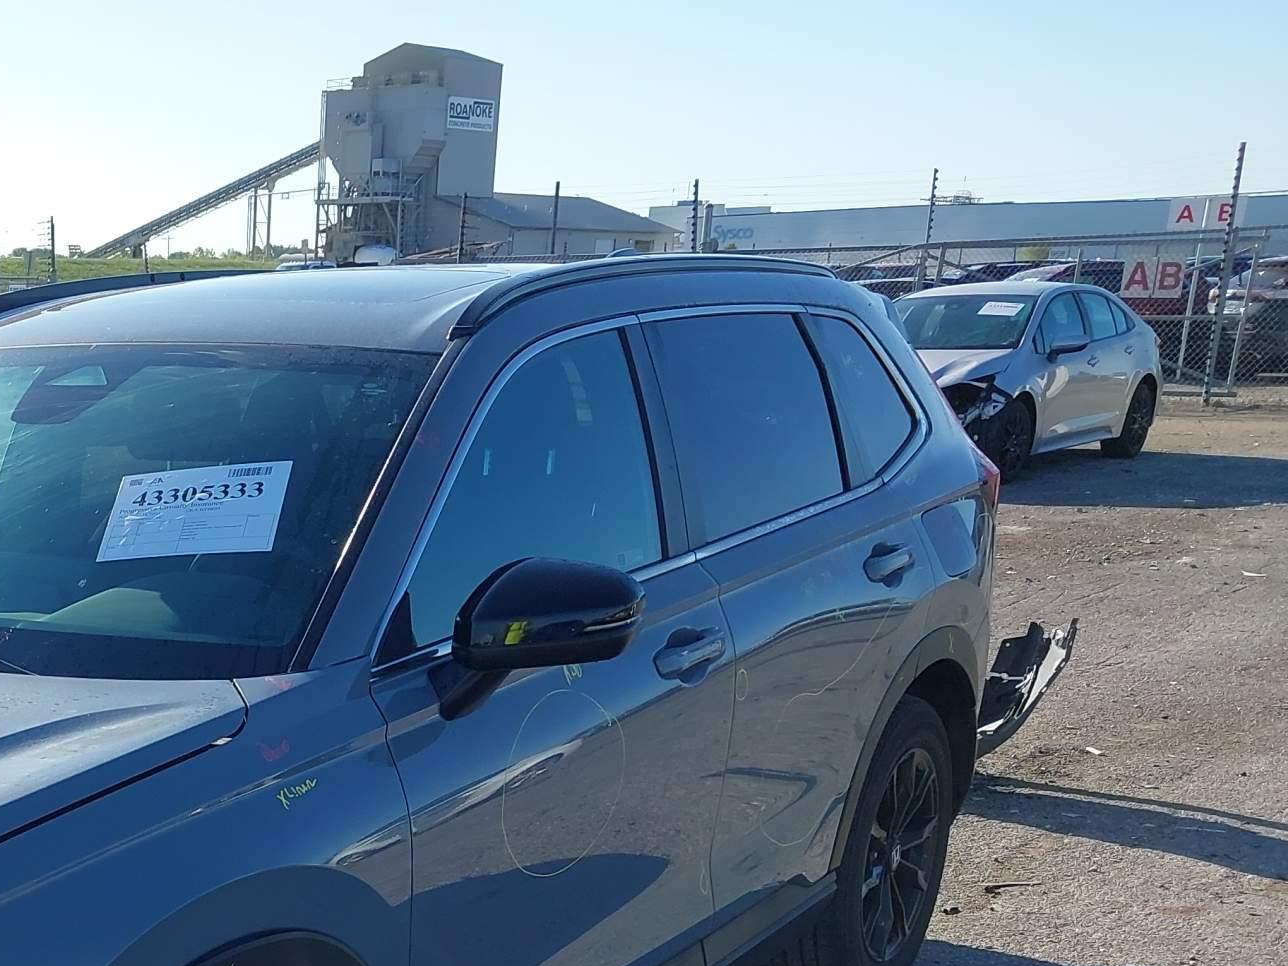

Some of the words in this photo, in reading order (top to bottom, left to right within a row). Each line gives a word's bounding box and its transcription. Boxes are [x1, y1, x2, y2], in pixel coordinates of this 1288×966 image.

[449, 101, 493, 119] ROANOKE
[1175, 204, 1194, 223] A
[132, 481, 264, 507] 43305333
